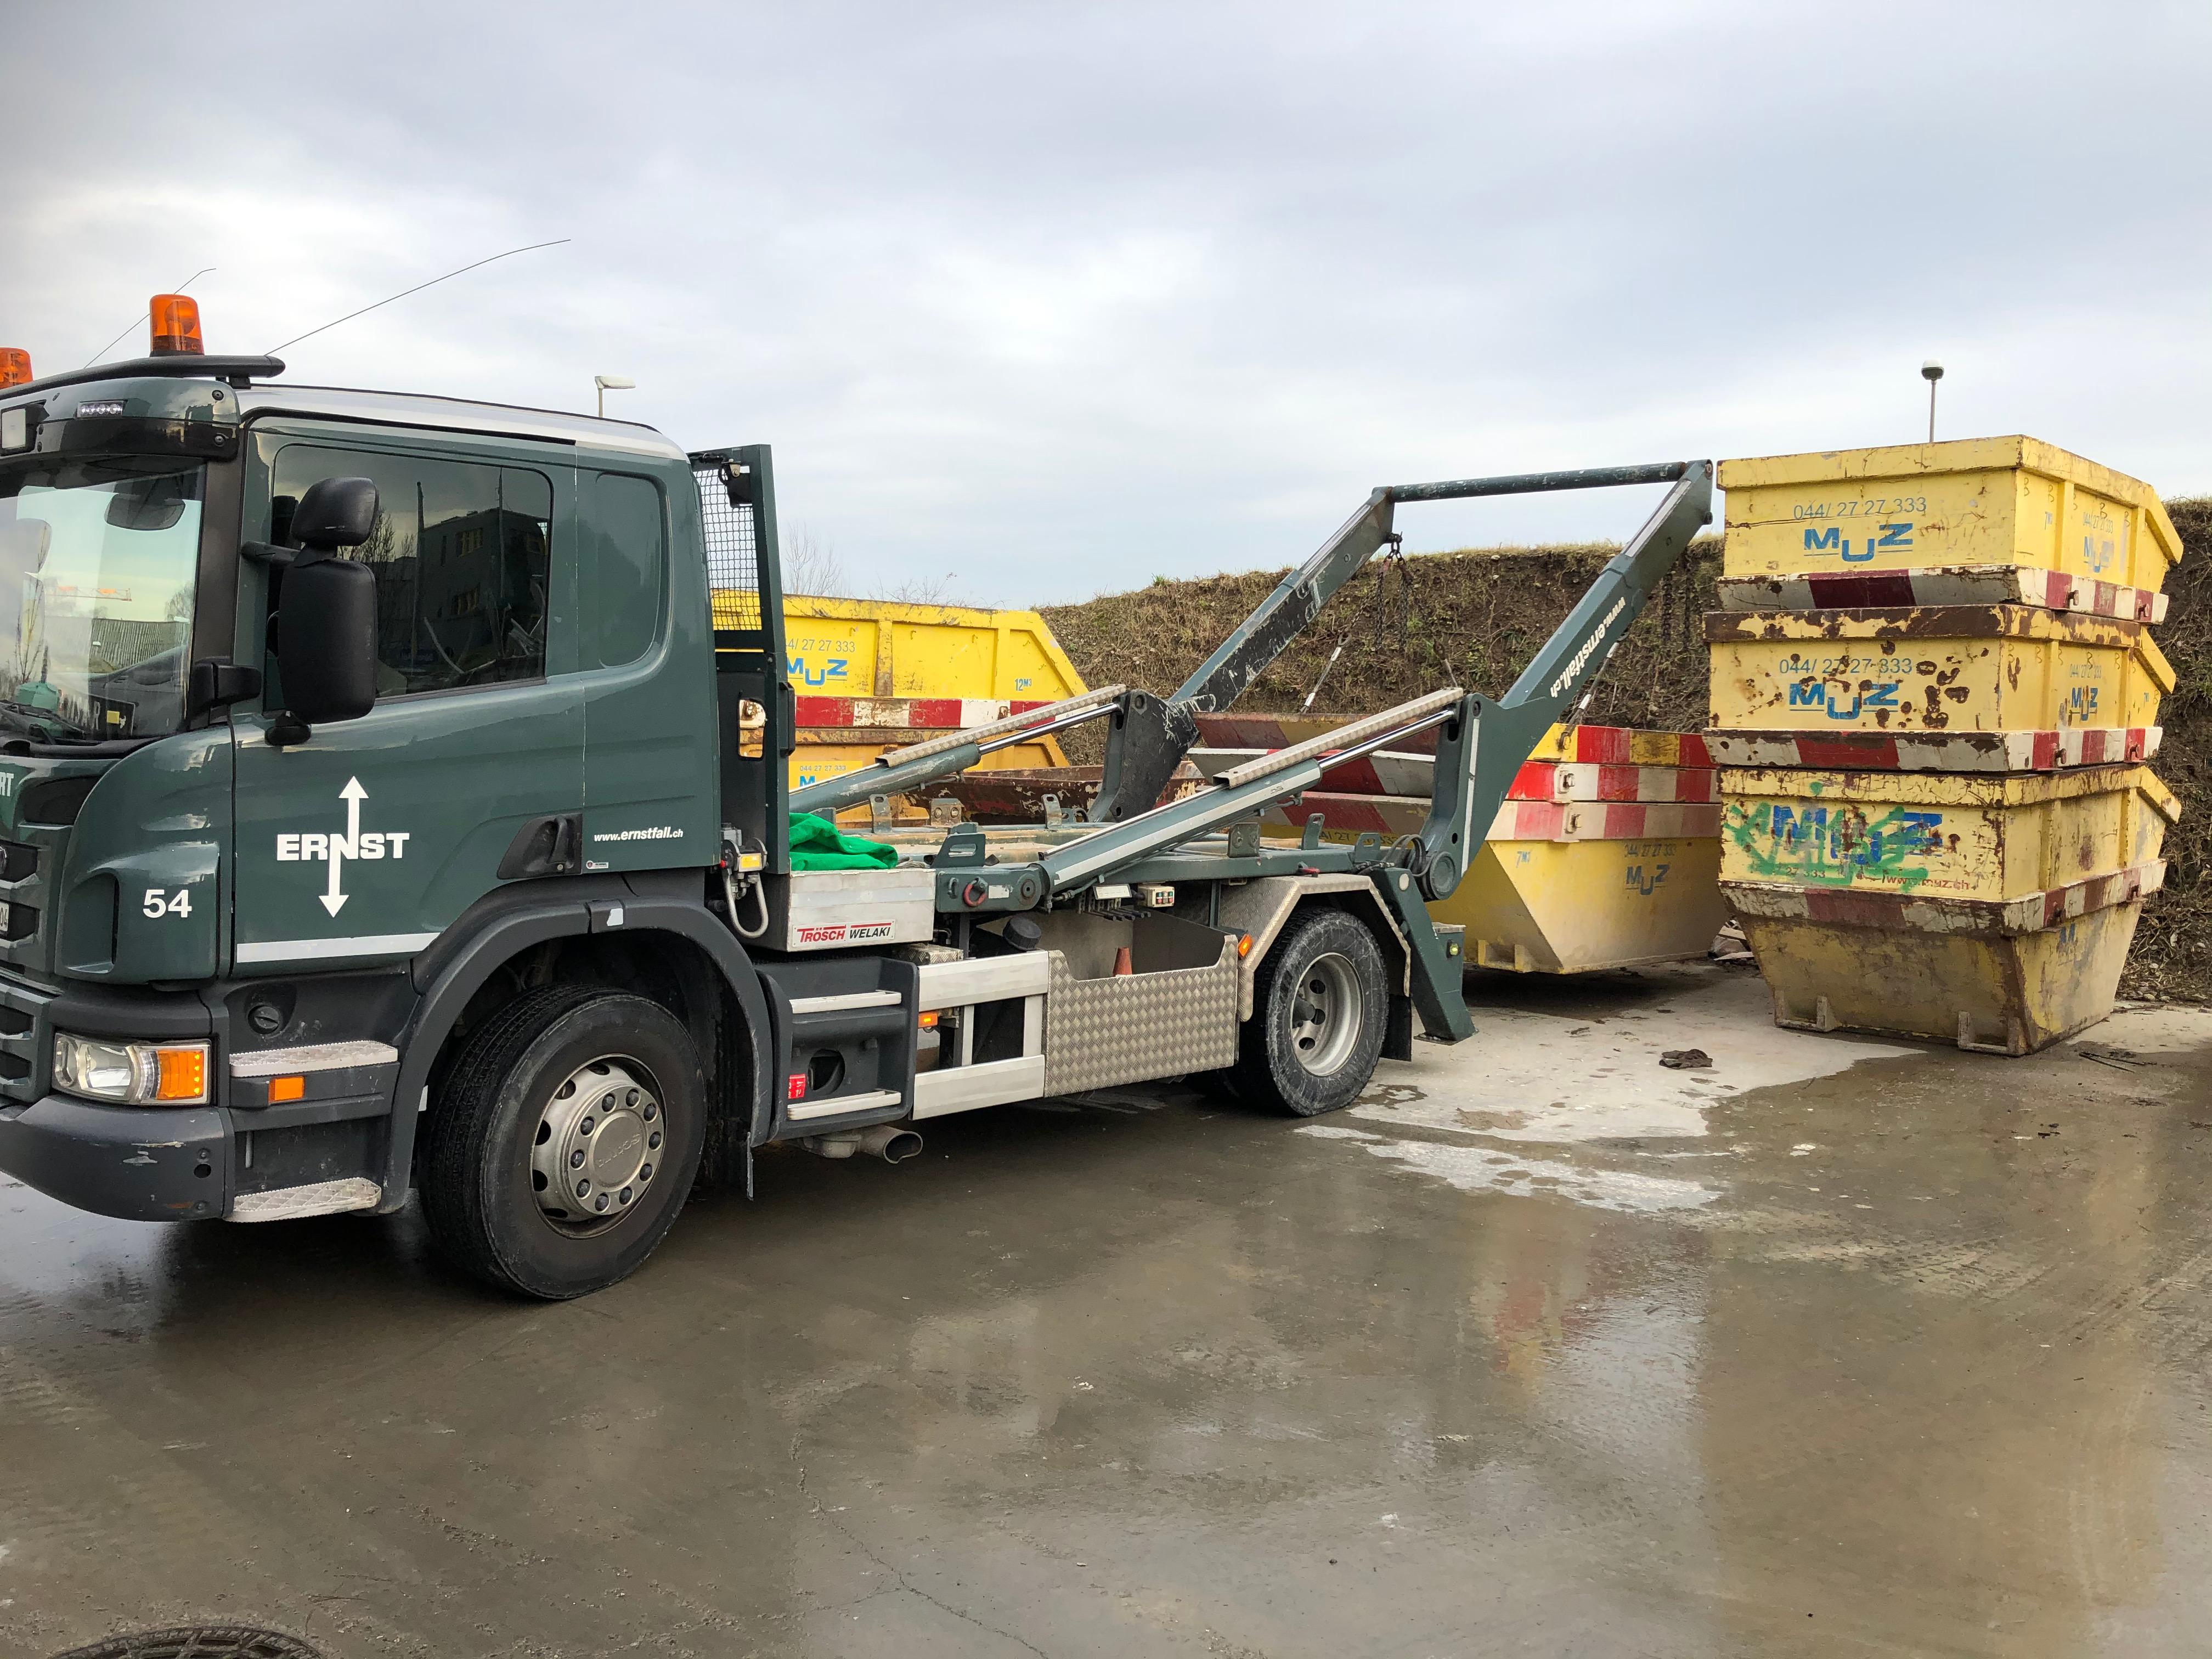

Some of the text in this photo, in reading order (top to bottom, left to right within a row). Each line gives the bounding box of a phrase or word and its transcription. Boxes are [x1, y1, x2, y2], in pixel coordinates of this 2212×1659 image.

[1793, 496, 1927, 520] 044/ 27 27 333
[1804, 523, 1914, 562] MUZ
[786, 638, 855, 653] 4/ 27 27 333
[1550, 596, 1626, 698] www.ernstfall.ch
[787, 658, 848, 686] MUZ
[1779, 658, 1818, 674] 044/
[1850, 658, 1872, 674] 27
[1878, 658, 1912, 674] 333
[1789, 683, 1899, 720] MUZ
[2071, 687, 2098, 721] MUZ
[276, 832, 410, 861] ERNST
[594, 826, 684, 842] www.ernstfall.ch
[1625, 864, 1670, 896] MUZ
[143, 889, 193, 918] 54
[797, 926, 891, 943] TRÖSCH WELAKI
